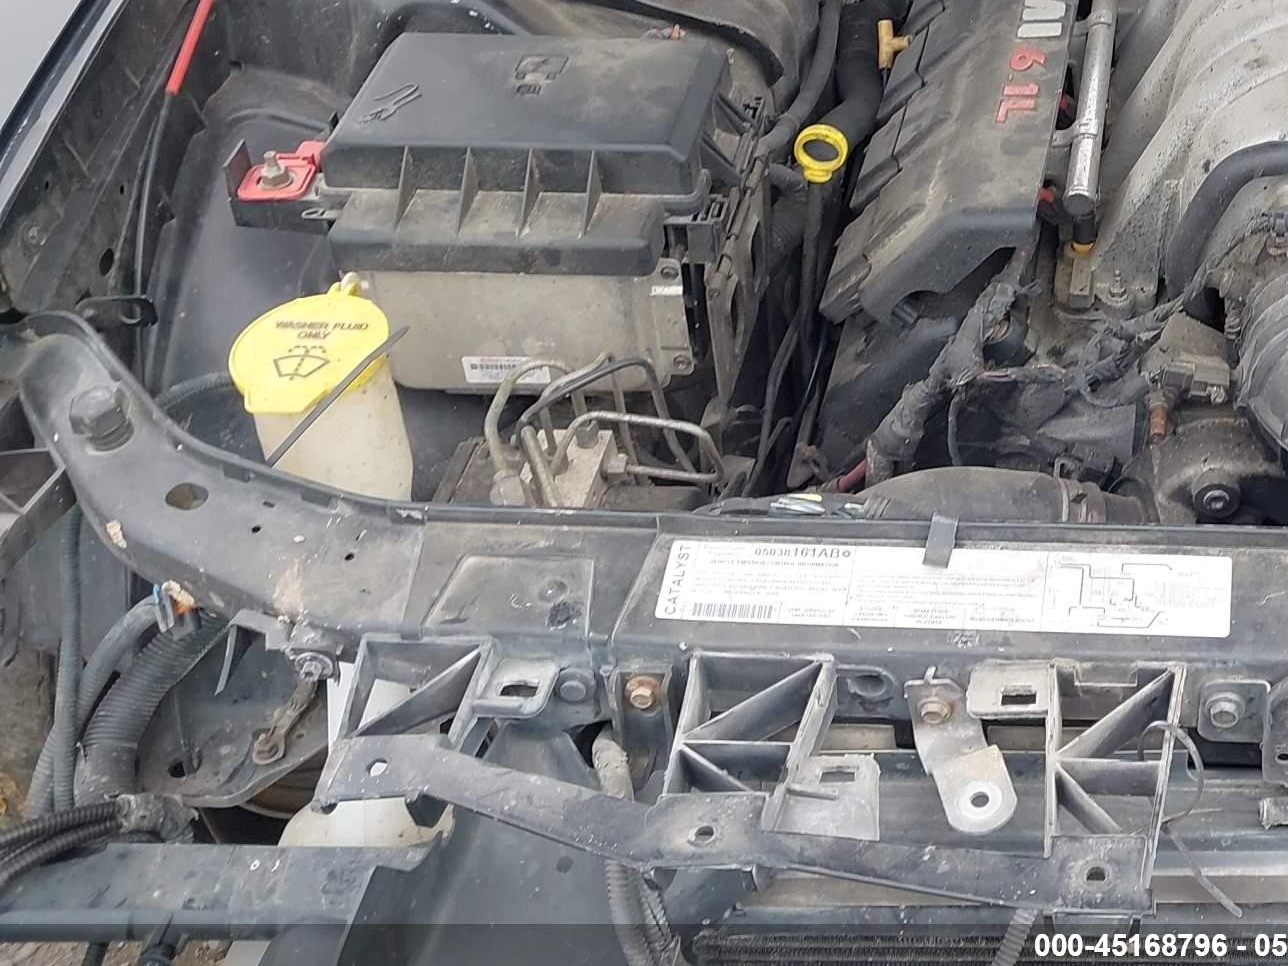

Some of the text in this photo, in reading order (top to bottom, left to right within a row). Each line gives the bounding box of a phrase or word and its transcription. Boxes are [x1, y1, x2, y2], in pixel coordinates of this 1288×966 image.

[994, 44, 1046, 124] 6.1L
[275, 320, 370, 331] WASHER FLUID
[296, 331, 332, 340] ONLY
[664, 545, 692, 615] CATALYST
